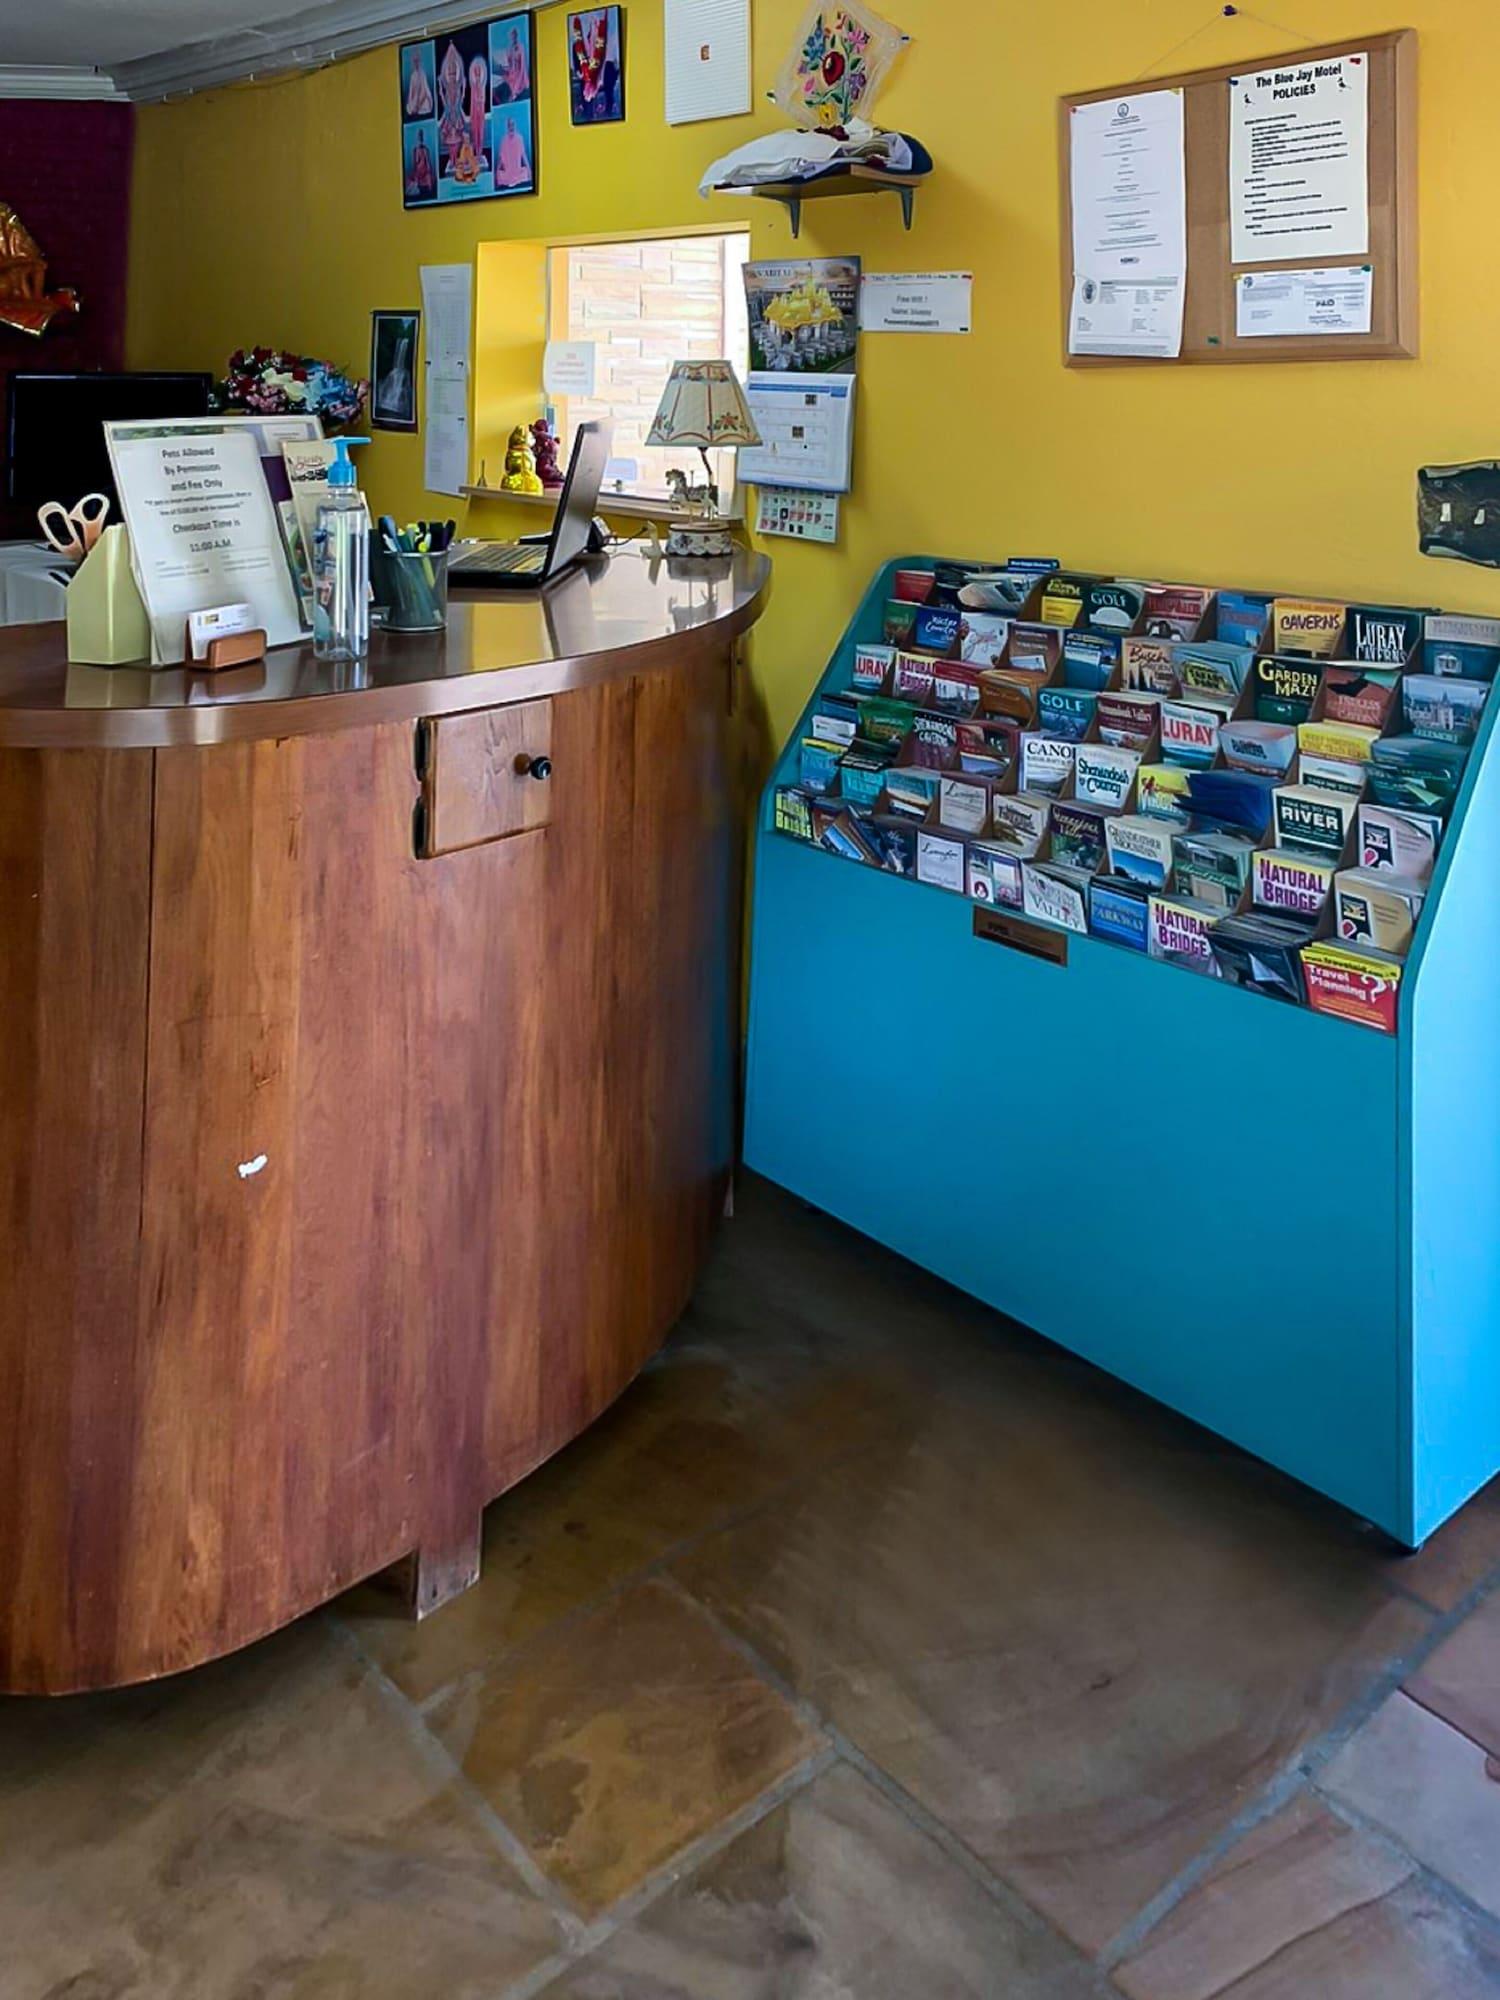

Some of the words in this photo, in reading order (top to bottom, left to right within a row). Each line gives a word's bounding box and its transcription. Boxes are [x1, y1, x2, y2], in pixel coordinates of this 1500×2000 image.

[1256, 76, 1272, 88] The
[1274, 73, 1294, 85] Blue
[1296, 70, 1313, 82] Jay
[1315, 63, 1342, 78] Motel
[1273, 84, 1316, 100] POLICIES
[162, 449, 181, 458] Pets
[182, 447, 215, 457] Allowed
[164, 466, 175, 476] By
[177, 464, 221, 473] Permission
[171, 482, 187, 491] and
[188, 481, 202, 489] Fee
[204, 479, 223, 488] Only
[172, 523, 211, 534] Checkout
[212, 520, 232, 529] Time
[189, 541, 212, 552] 11:00
[1091, 591, 1127, 608] GOLF
[1281, 613, 1341, 631] CAVERNS
[1355, 613, 1406, 651] LURAY
[1130, 647, 1169, 663] Busch
[1258, 658, 1318, 686] GARDEN
[1040, 693, 1084, 712] GOLF
[1163, 716, 1214, 747] LURAY
[1027, 741, 1076, 759] CANO
[1079, 757, 1130, 785] Shenandoah
[1087, 777, 1121, 799] County
[1281, 806, 1339, 830] RIVER
[1260, 858, 1326, 894] NATURAL
[1263, 881, 1319, 911] BRIDGE
[1154, 903, 1210, 936] NATURA
[1158, 924, 1209, 958] BRIDGE
[1310, 965, 1350, 982] Travel
[1310, 975, 1367, 1001] Planning
